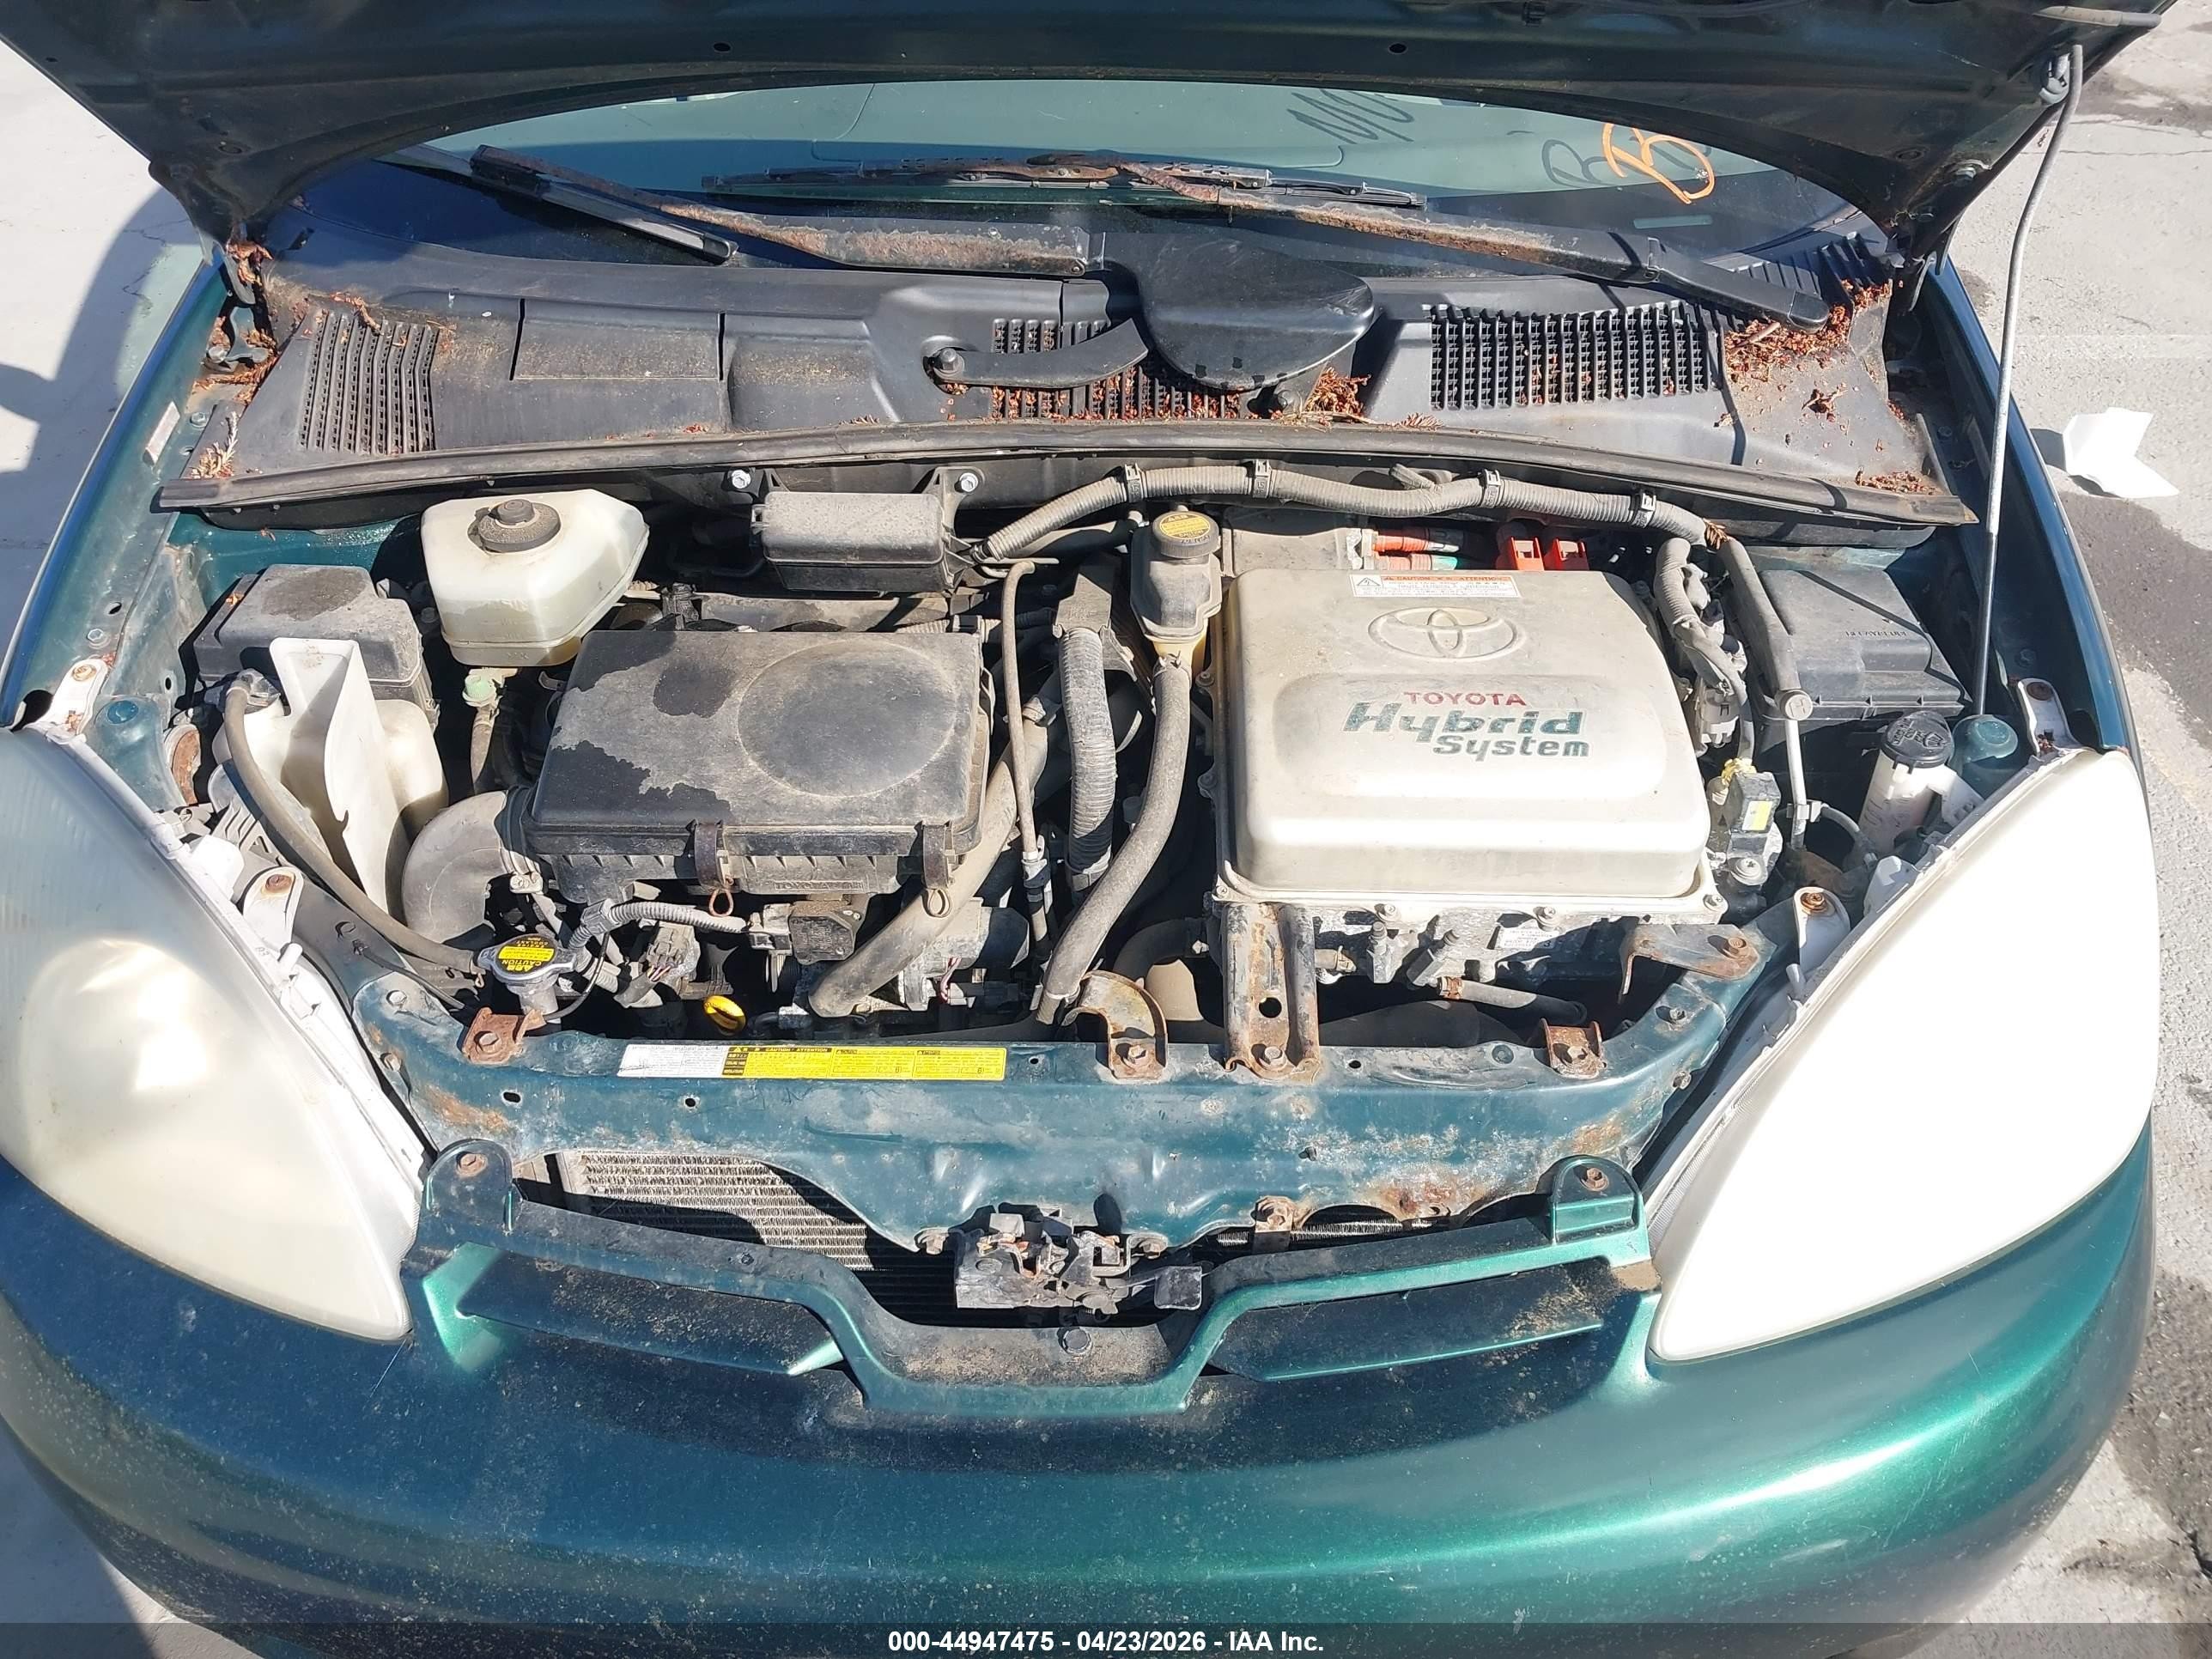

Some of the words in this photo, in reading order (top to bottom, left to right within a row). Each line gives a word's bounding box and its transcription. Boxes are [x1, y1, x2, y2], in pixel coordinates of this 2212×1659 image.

[1403, 691, 1527, 707] TOYOTA
[1342, 702, 1584, 744] Hybrid
[1432, 734, 1590, 763] System
